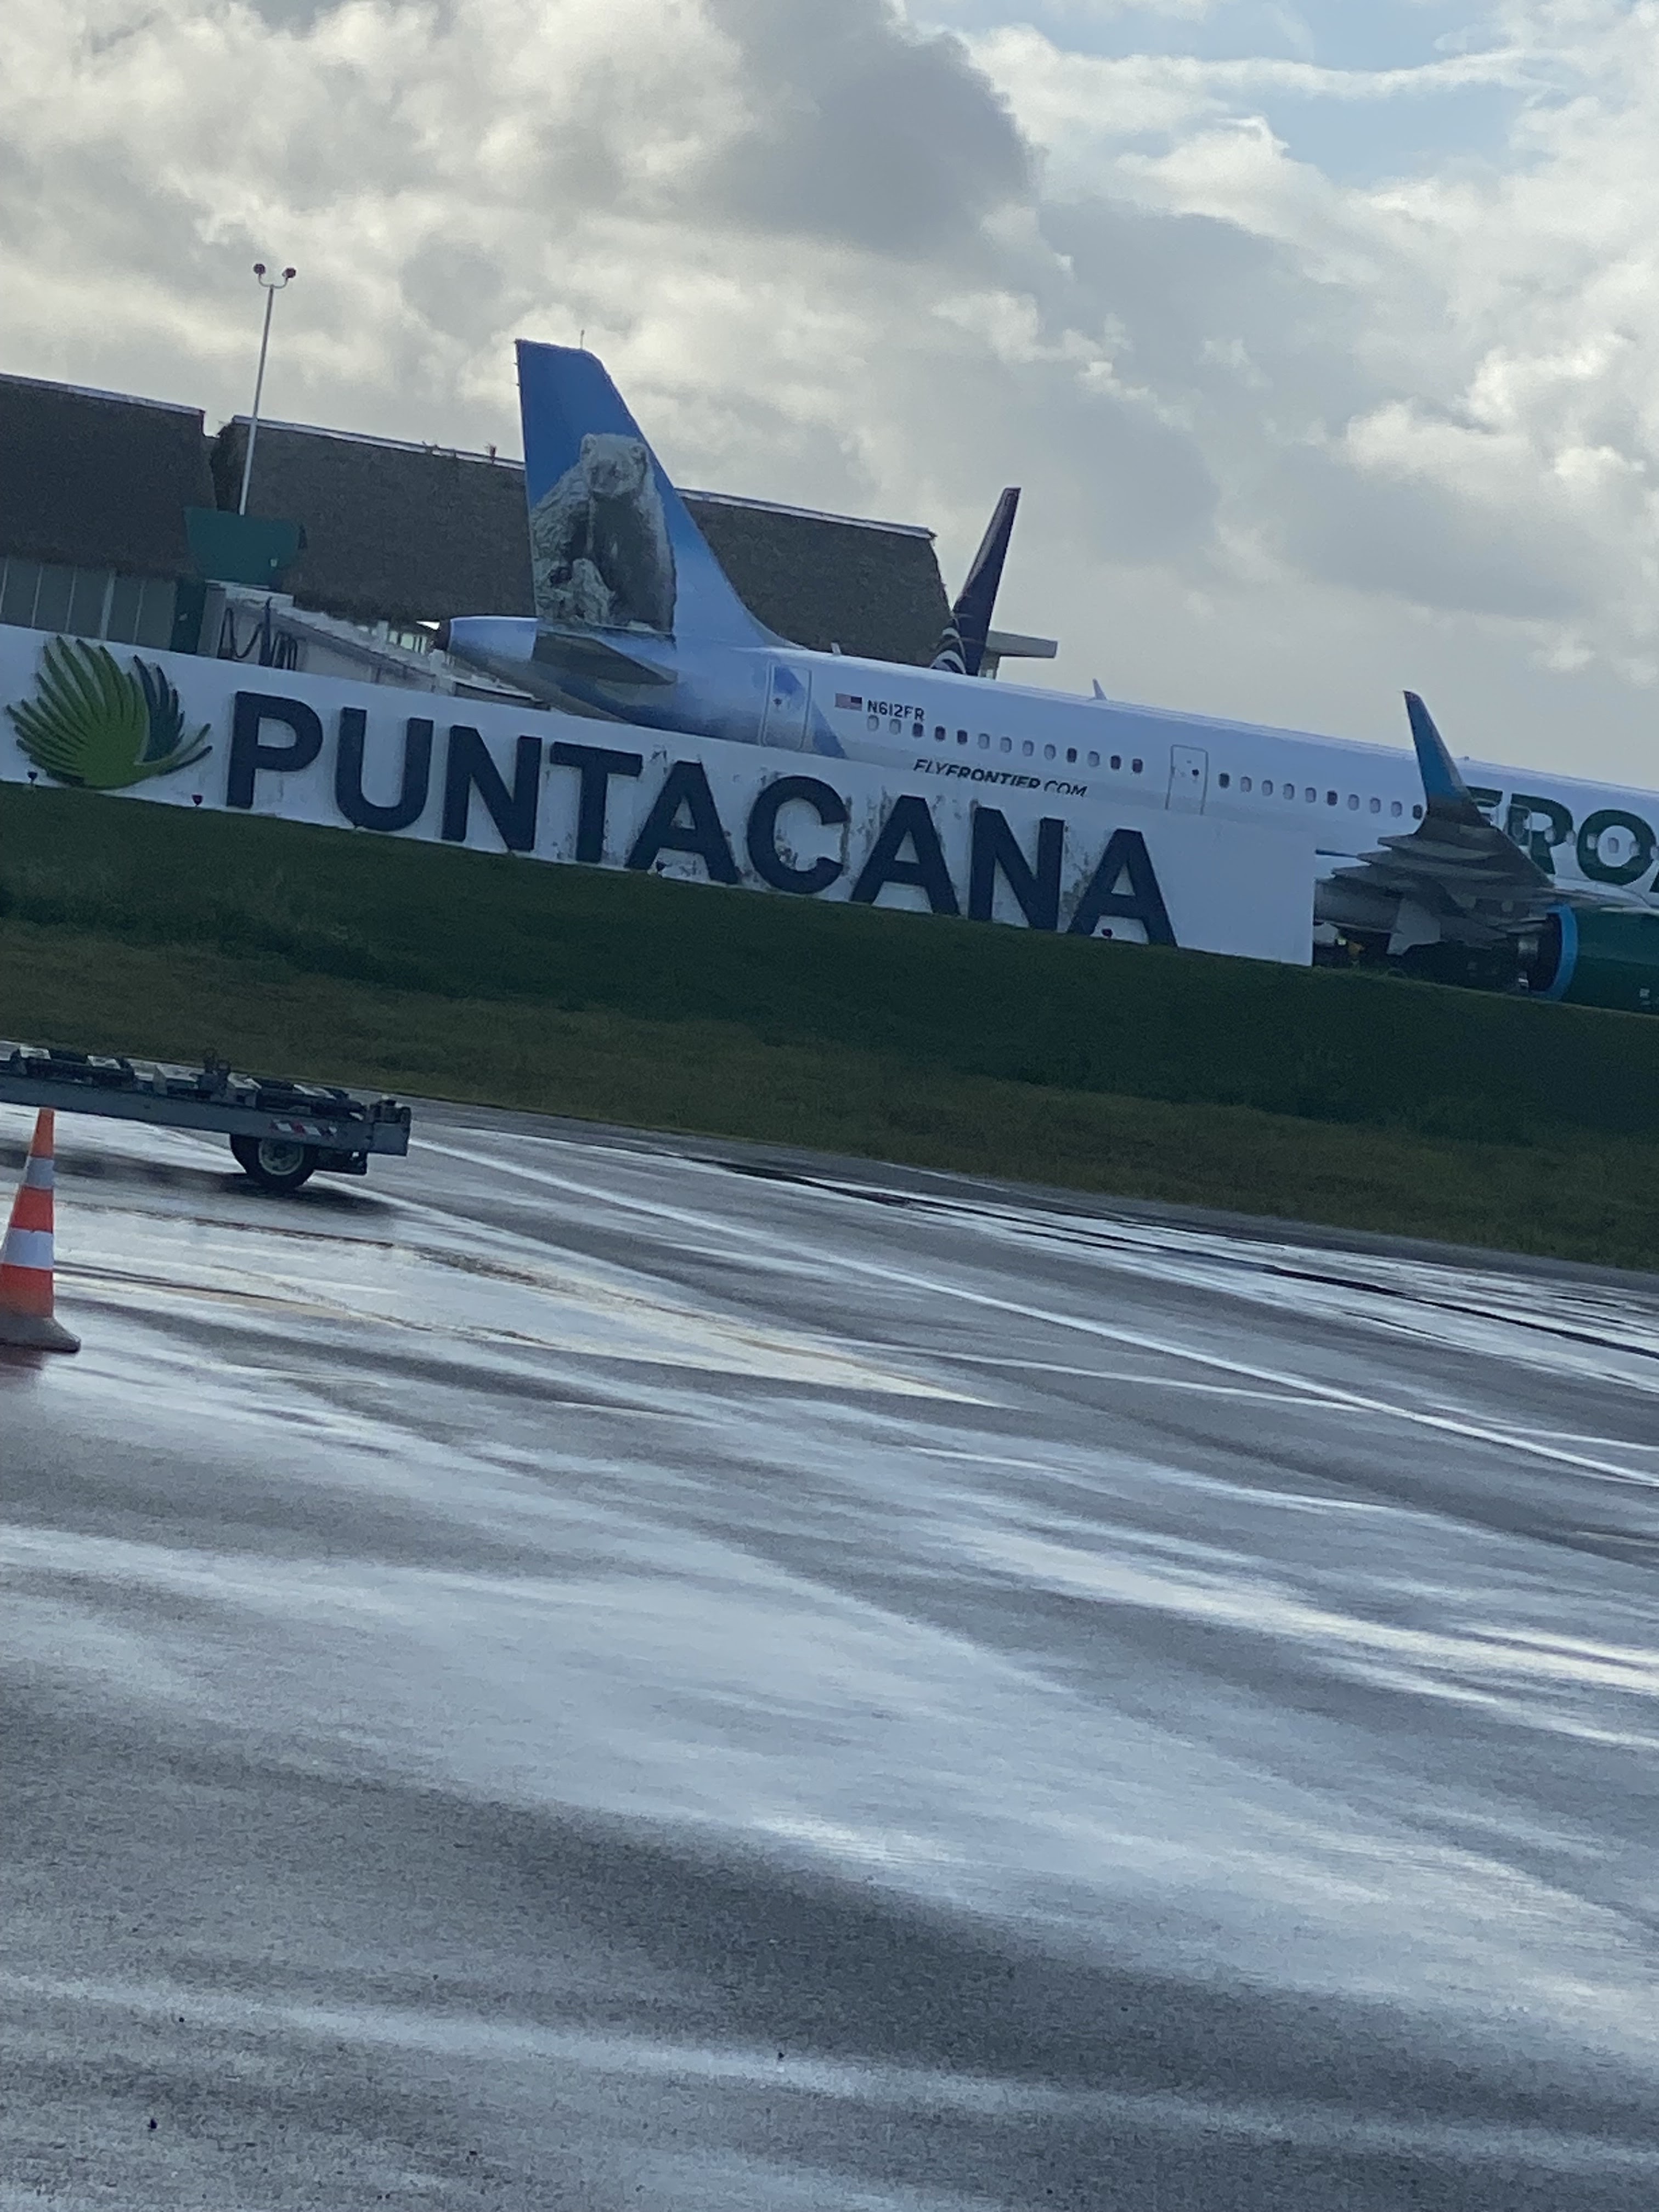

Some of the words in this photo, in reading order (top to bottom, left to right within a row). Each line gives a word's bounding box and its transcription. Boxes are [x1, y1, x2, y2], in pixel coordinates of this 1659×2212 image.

[867, 699, 924, 721] N612FR
[913, 759, 1087, 797] FLYFRONTIERCOM
[225, 690, 1177, 947] PUNTACANA
[1466, 786, 1659, 893] RO
